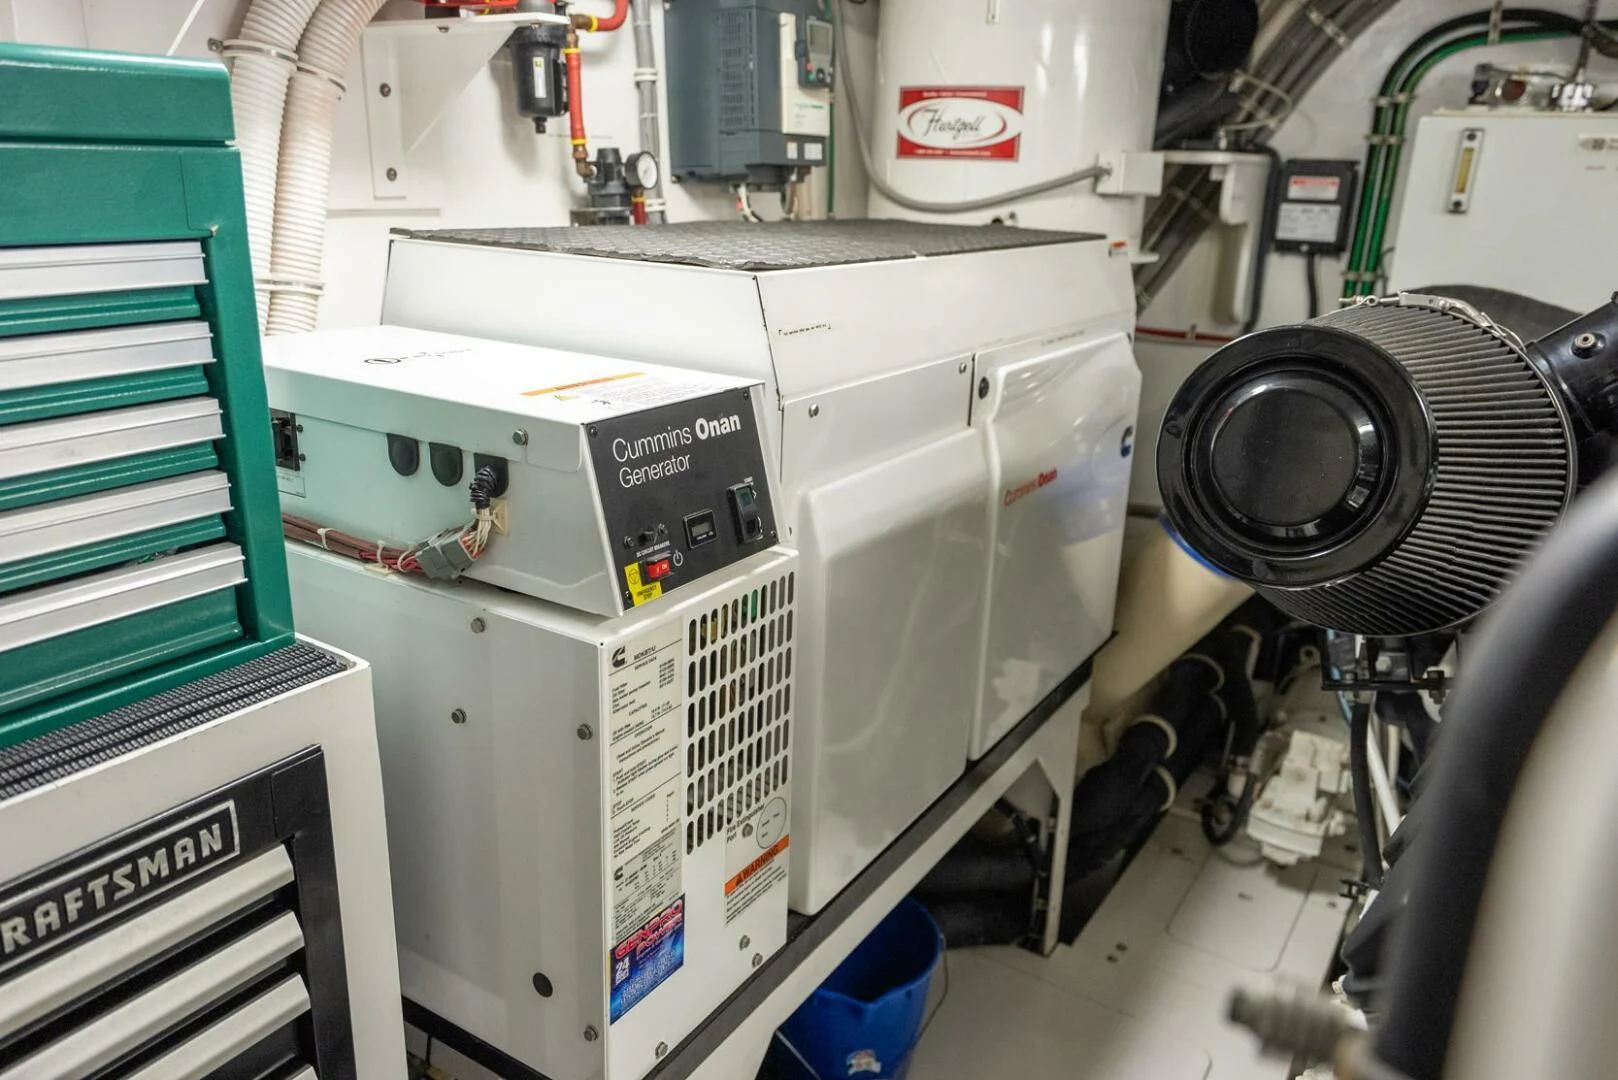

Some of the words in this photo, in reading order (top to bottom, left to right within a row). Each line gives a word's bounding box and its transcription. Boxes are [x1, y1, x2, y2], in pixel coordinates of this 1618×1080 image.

[612, 426, 692, 462] Cummins
[695, 414, 741, 440] Onan
[619, 454, 690, 488] Generator
[742, 844, 778, 880] WARNING
